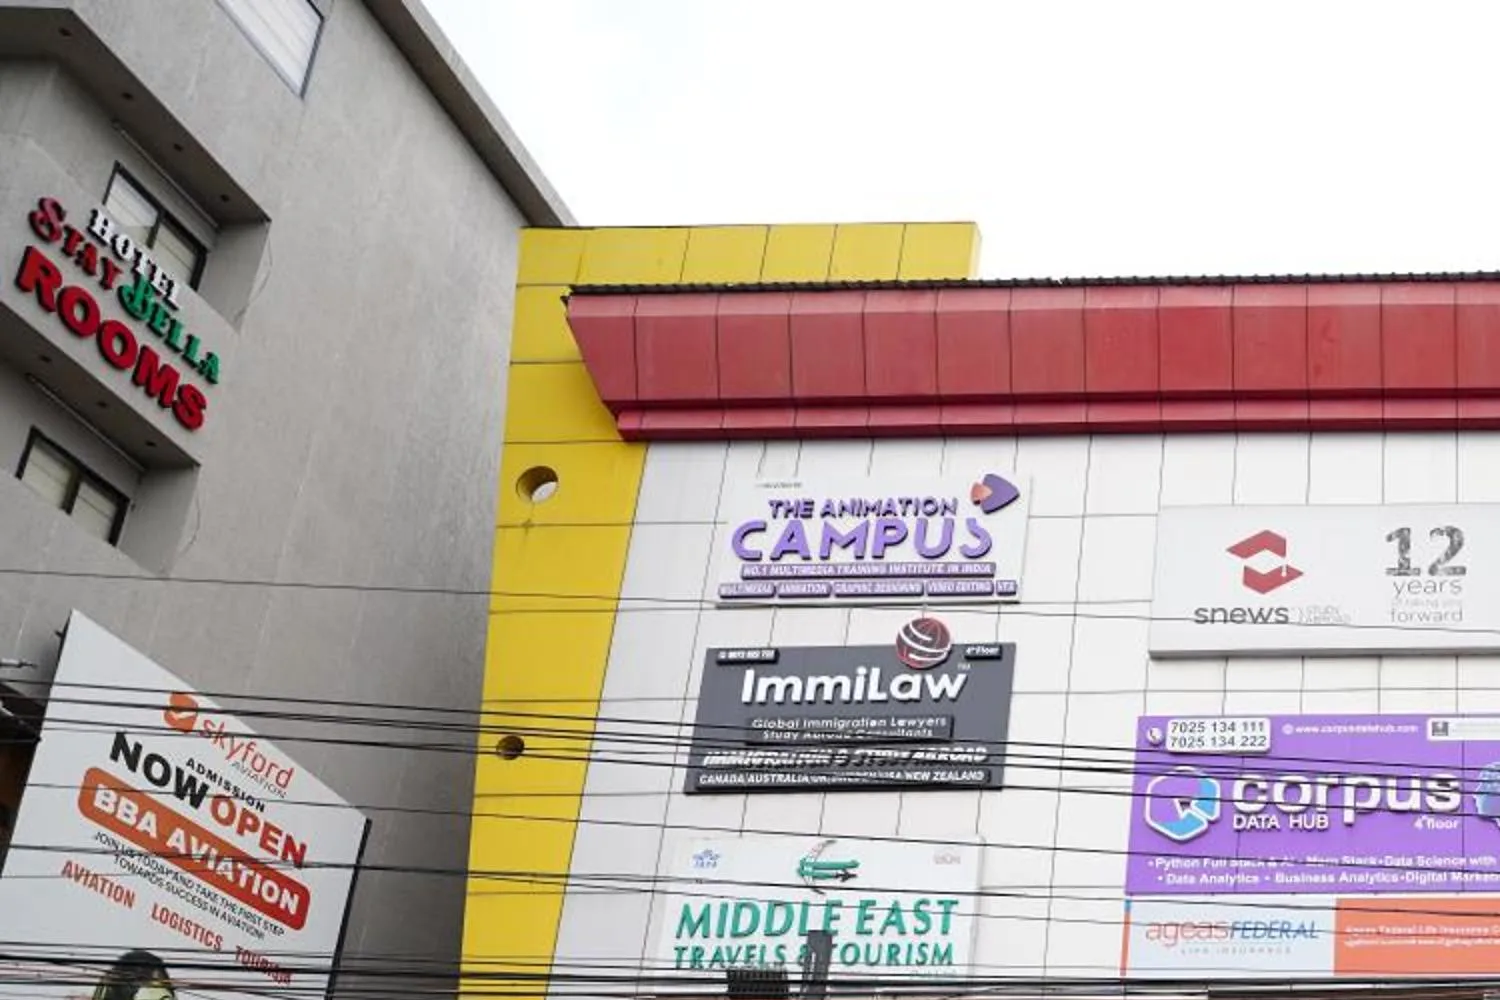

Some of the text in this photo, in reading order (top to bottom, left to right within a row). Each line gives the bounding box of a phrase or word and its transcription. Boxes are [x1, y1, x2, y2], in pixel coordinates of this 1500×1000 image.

[88, 208, 180, 310] HOTEL
[30, 198, 221, 384] STAY BELLA
[17, 246, 207, 431] ROOMS
[769, 497, 959, 519] THE ANIMATION
[731, 517, 993, 561] CAMPUS
[1385, 525, 1467, 577] 12
[1393, 578, 1462, 599] years
[1194, 605, 1289, 626] snews
[1390, 607, 1463, 623] forward
[741, 666, 967, 704] ImmiLaw
[752, 718, 801, 730] Global
[891, 716, 946, 730] Lawyers
[1171, 721, 1264, 733] 7025 134 111
[1171, 735, 1267, 748] 7025 134 222
[200, 718, 295, 790] skyford
[109, 731, 308, 868] NOW OPEN
[186, 757, 266, 813] ADMISSION
[1232, 772, 1463, 827] corpus
[1233, 814, 1329, 830] DATA HUB
[94, 783, 301, 916] BBA AVIATION
[61, 860, 137, 910] AVIATION
[151, 902, 224, 952] LOGISTICS
[856, 898, 960, 936] EAST
[674, 942, 953, 970] TRAVELS OURISM
